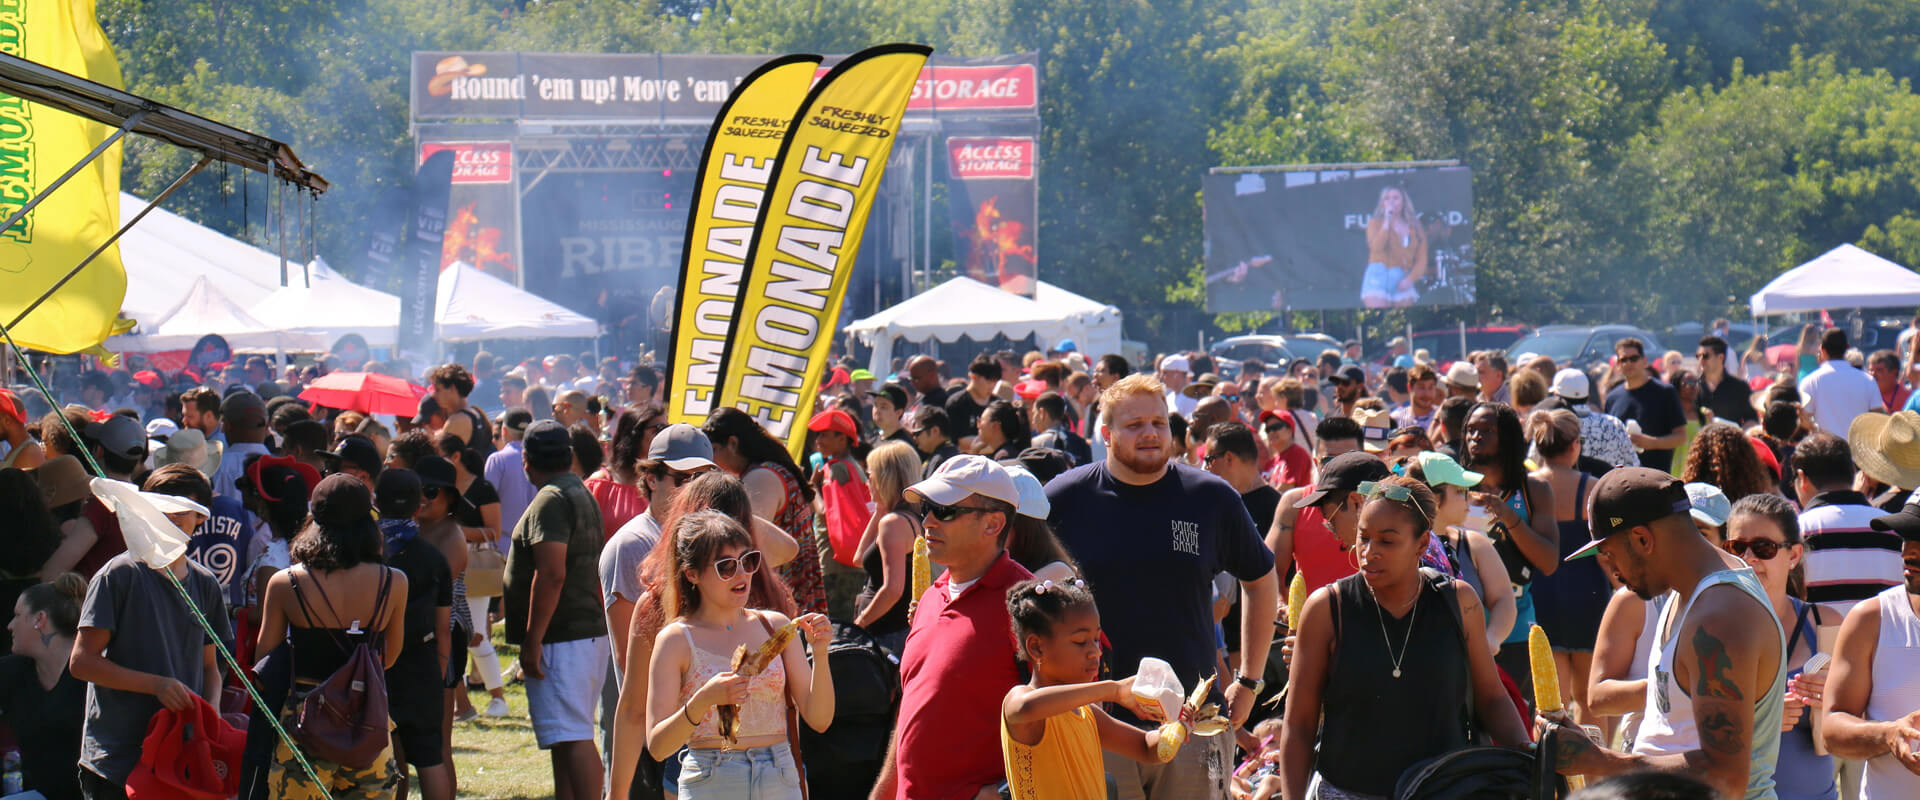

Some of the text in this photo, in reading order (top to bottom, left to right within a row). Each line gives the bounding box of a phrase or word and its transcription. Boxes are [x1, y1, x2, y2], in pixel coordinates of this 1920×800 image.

[451, 74, 526, 100] Round
[580, 76, 617, 104] up!
[623, 76, 681, 101] Move
[910, 78, 1021, 99] STORAGE
[733, 115, 791, 128] FRESHLY
[820, 106, 890, 125] FRESHLY
[723, 126, 785, 139] SQUEEZE
[808, 116, 890, 138] SQUEEZED
[958, 143, 1022, 160] ACCESS
[958, 160, 1022, 172] STORAGE
[579, 218, 686, 232] MISSISSAUG
[683, 153, 776, 417] EMONADE
[735, 145, 868, 442] EMONADE
